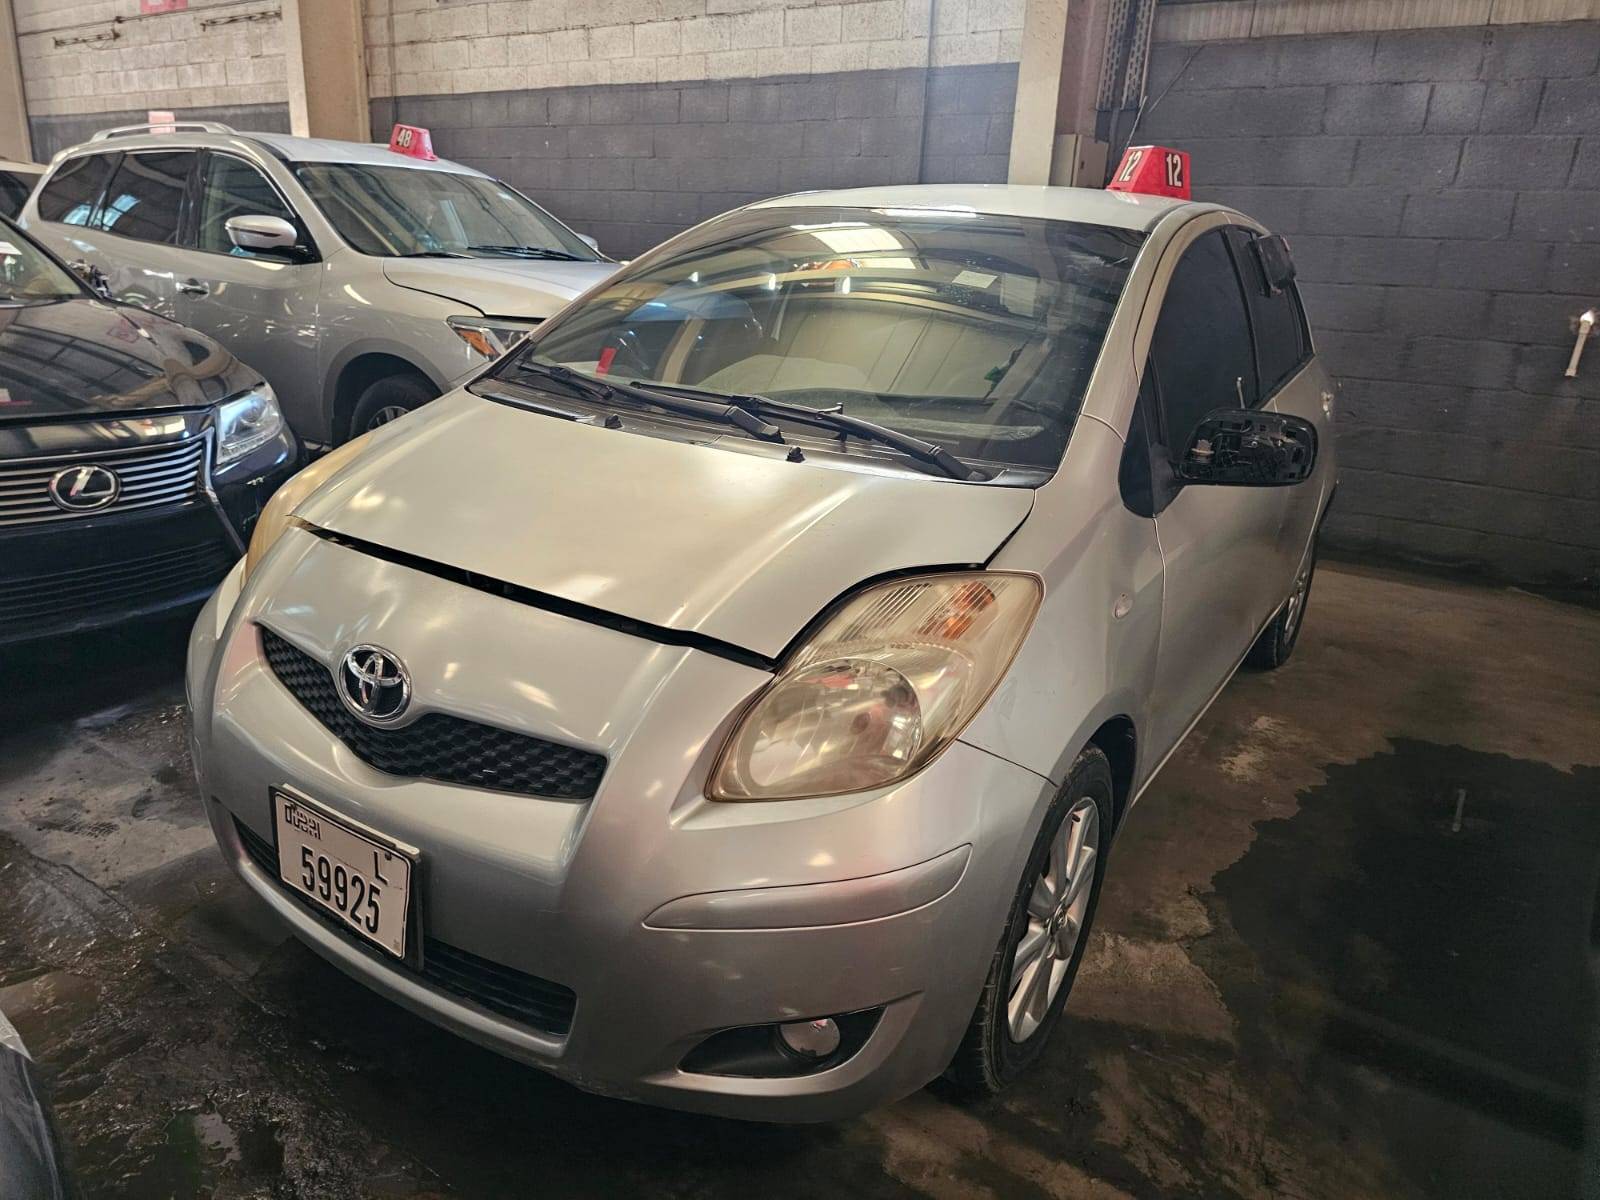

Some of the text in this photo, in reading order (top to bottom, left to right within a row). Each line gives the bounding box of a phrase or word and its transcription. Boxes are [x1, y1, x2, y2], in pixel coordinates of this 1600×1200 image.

[397, 128, 413, 148] 48
[1119, 151, 1142, 182] 12
[1166, 153, 1182, 187] 12
[373, 850, 388, 886] L
[301, 847, 380, 933] 59925
